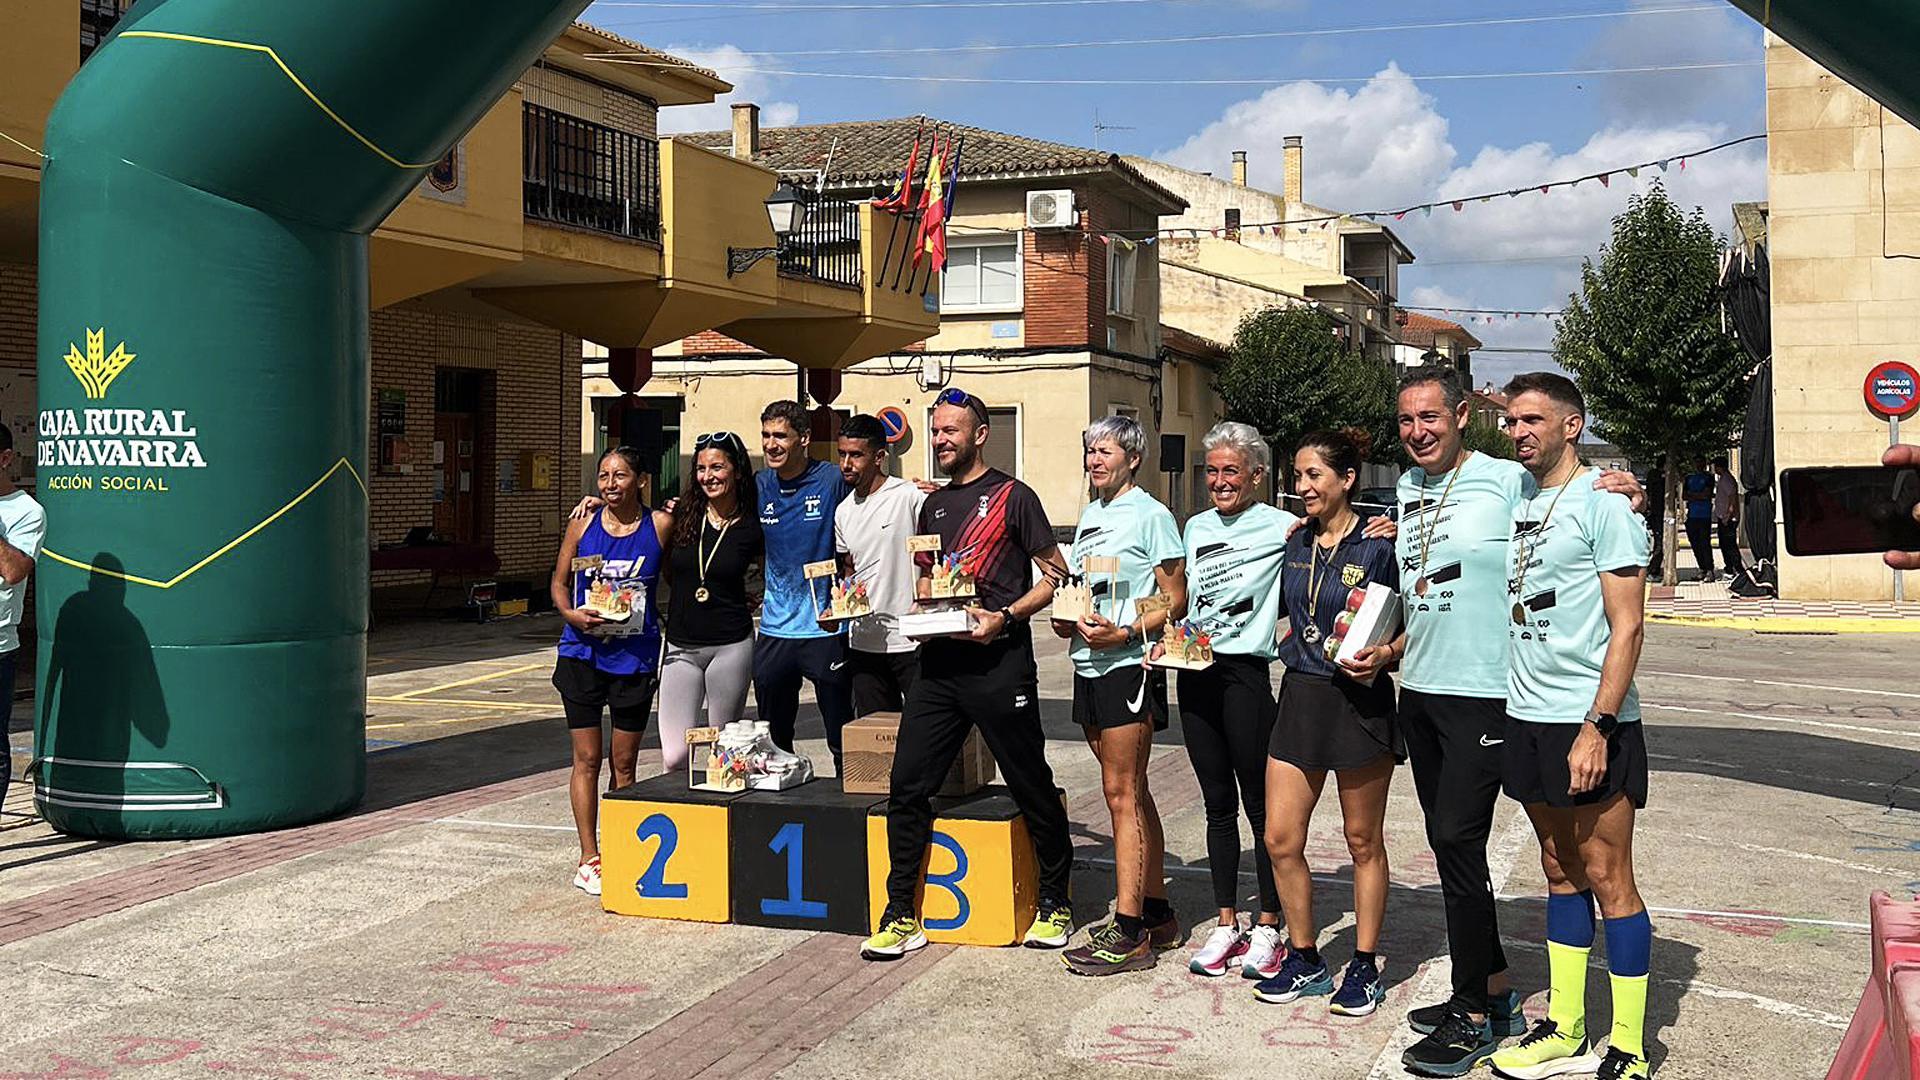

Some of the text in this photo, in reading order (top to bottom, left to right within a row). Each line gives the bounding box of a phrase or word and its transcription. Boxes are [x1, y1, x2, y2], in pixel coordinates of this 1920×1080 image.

[37, 440, 207, 467] DE NAVARRA
[39, 409, 197, 440] CAJA RURAL
[48, 474, 169, 491] ACCIÓN SOCIAL
[636, 813, 688, 898] 2
[761, 823, 828, 918] 1
[924, 831, 970, 929] 3
